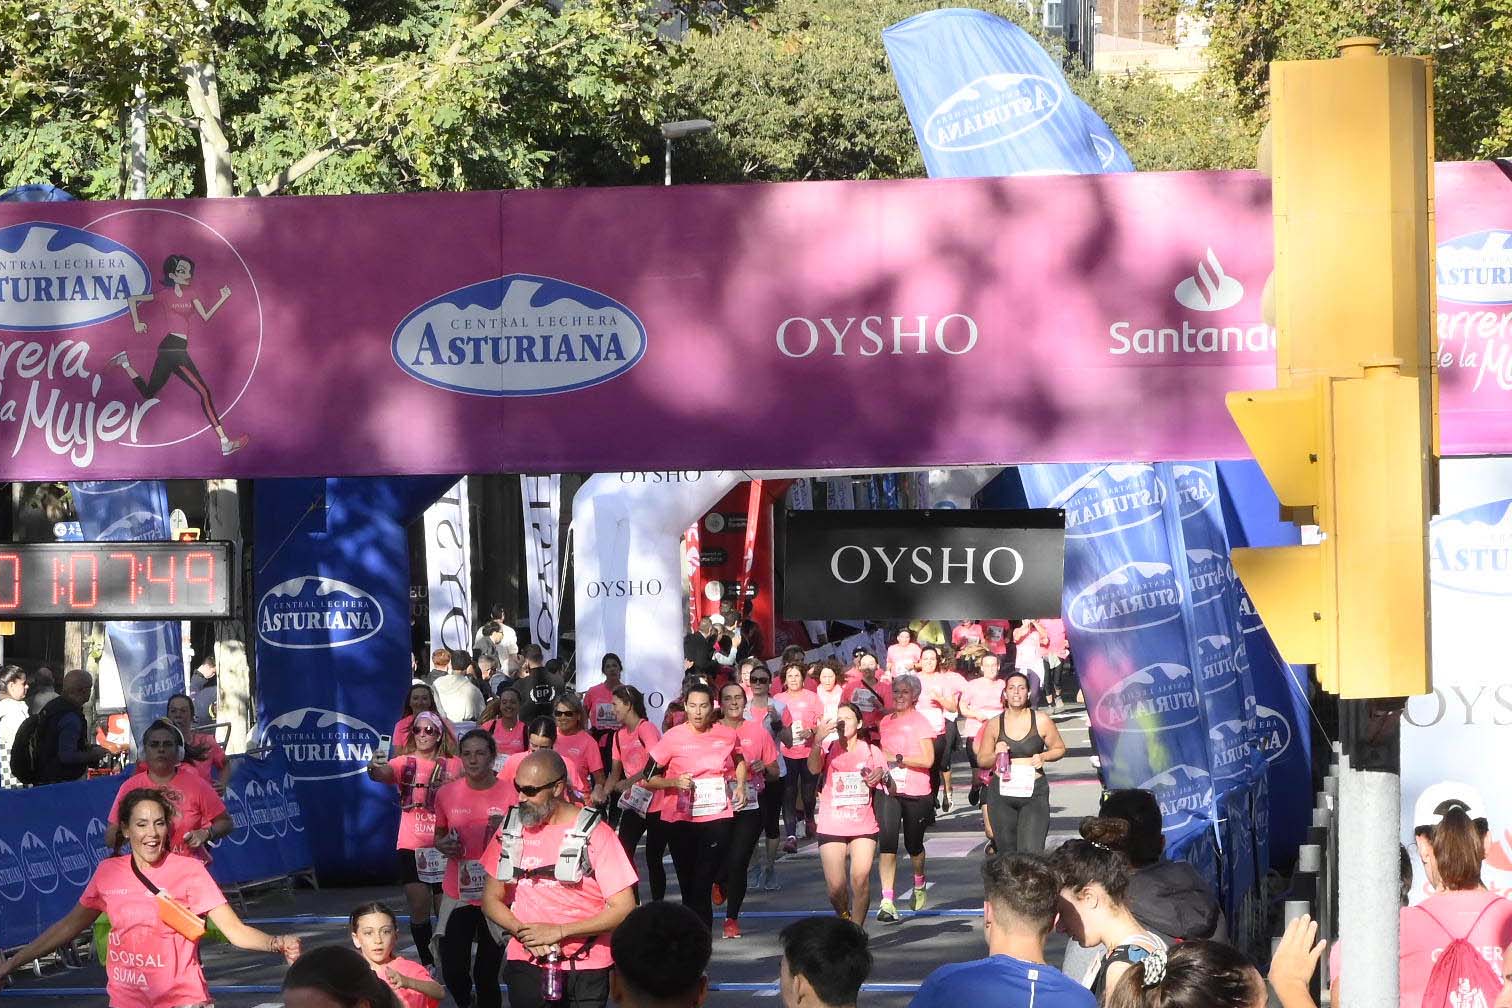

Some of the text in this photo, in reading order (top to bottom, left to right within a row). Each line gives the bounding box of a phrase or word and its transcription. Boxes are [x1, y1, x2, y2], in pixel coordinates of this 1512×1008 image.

[54, 259, 126, 269] LECHERA
[451, 315, 618, 330] CENTRAL LECHERA
[412, 321, 626, 366] ASTURIANA
[775, 313, 978, 358] OYSHO
[11, 373, 160, 467] Mujer
[831, 545, 1023, 585] OYSHO
[587, 579, 662, 598] OYSHO
[321, 600, 370, 608] LECHERA
[261, 605, 374, 632] ASTURIANA
[321, 732, 370, 740] LECHERA
[110, 950, 165, 968] DORSAL
[113, 967, 148, 986] SUMA
